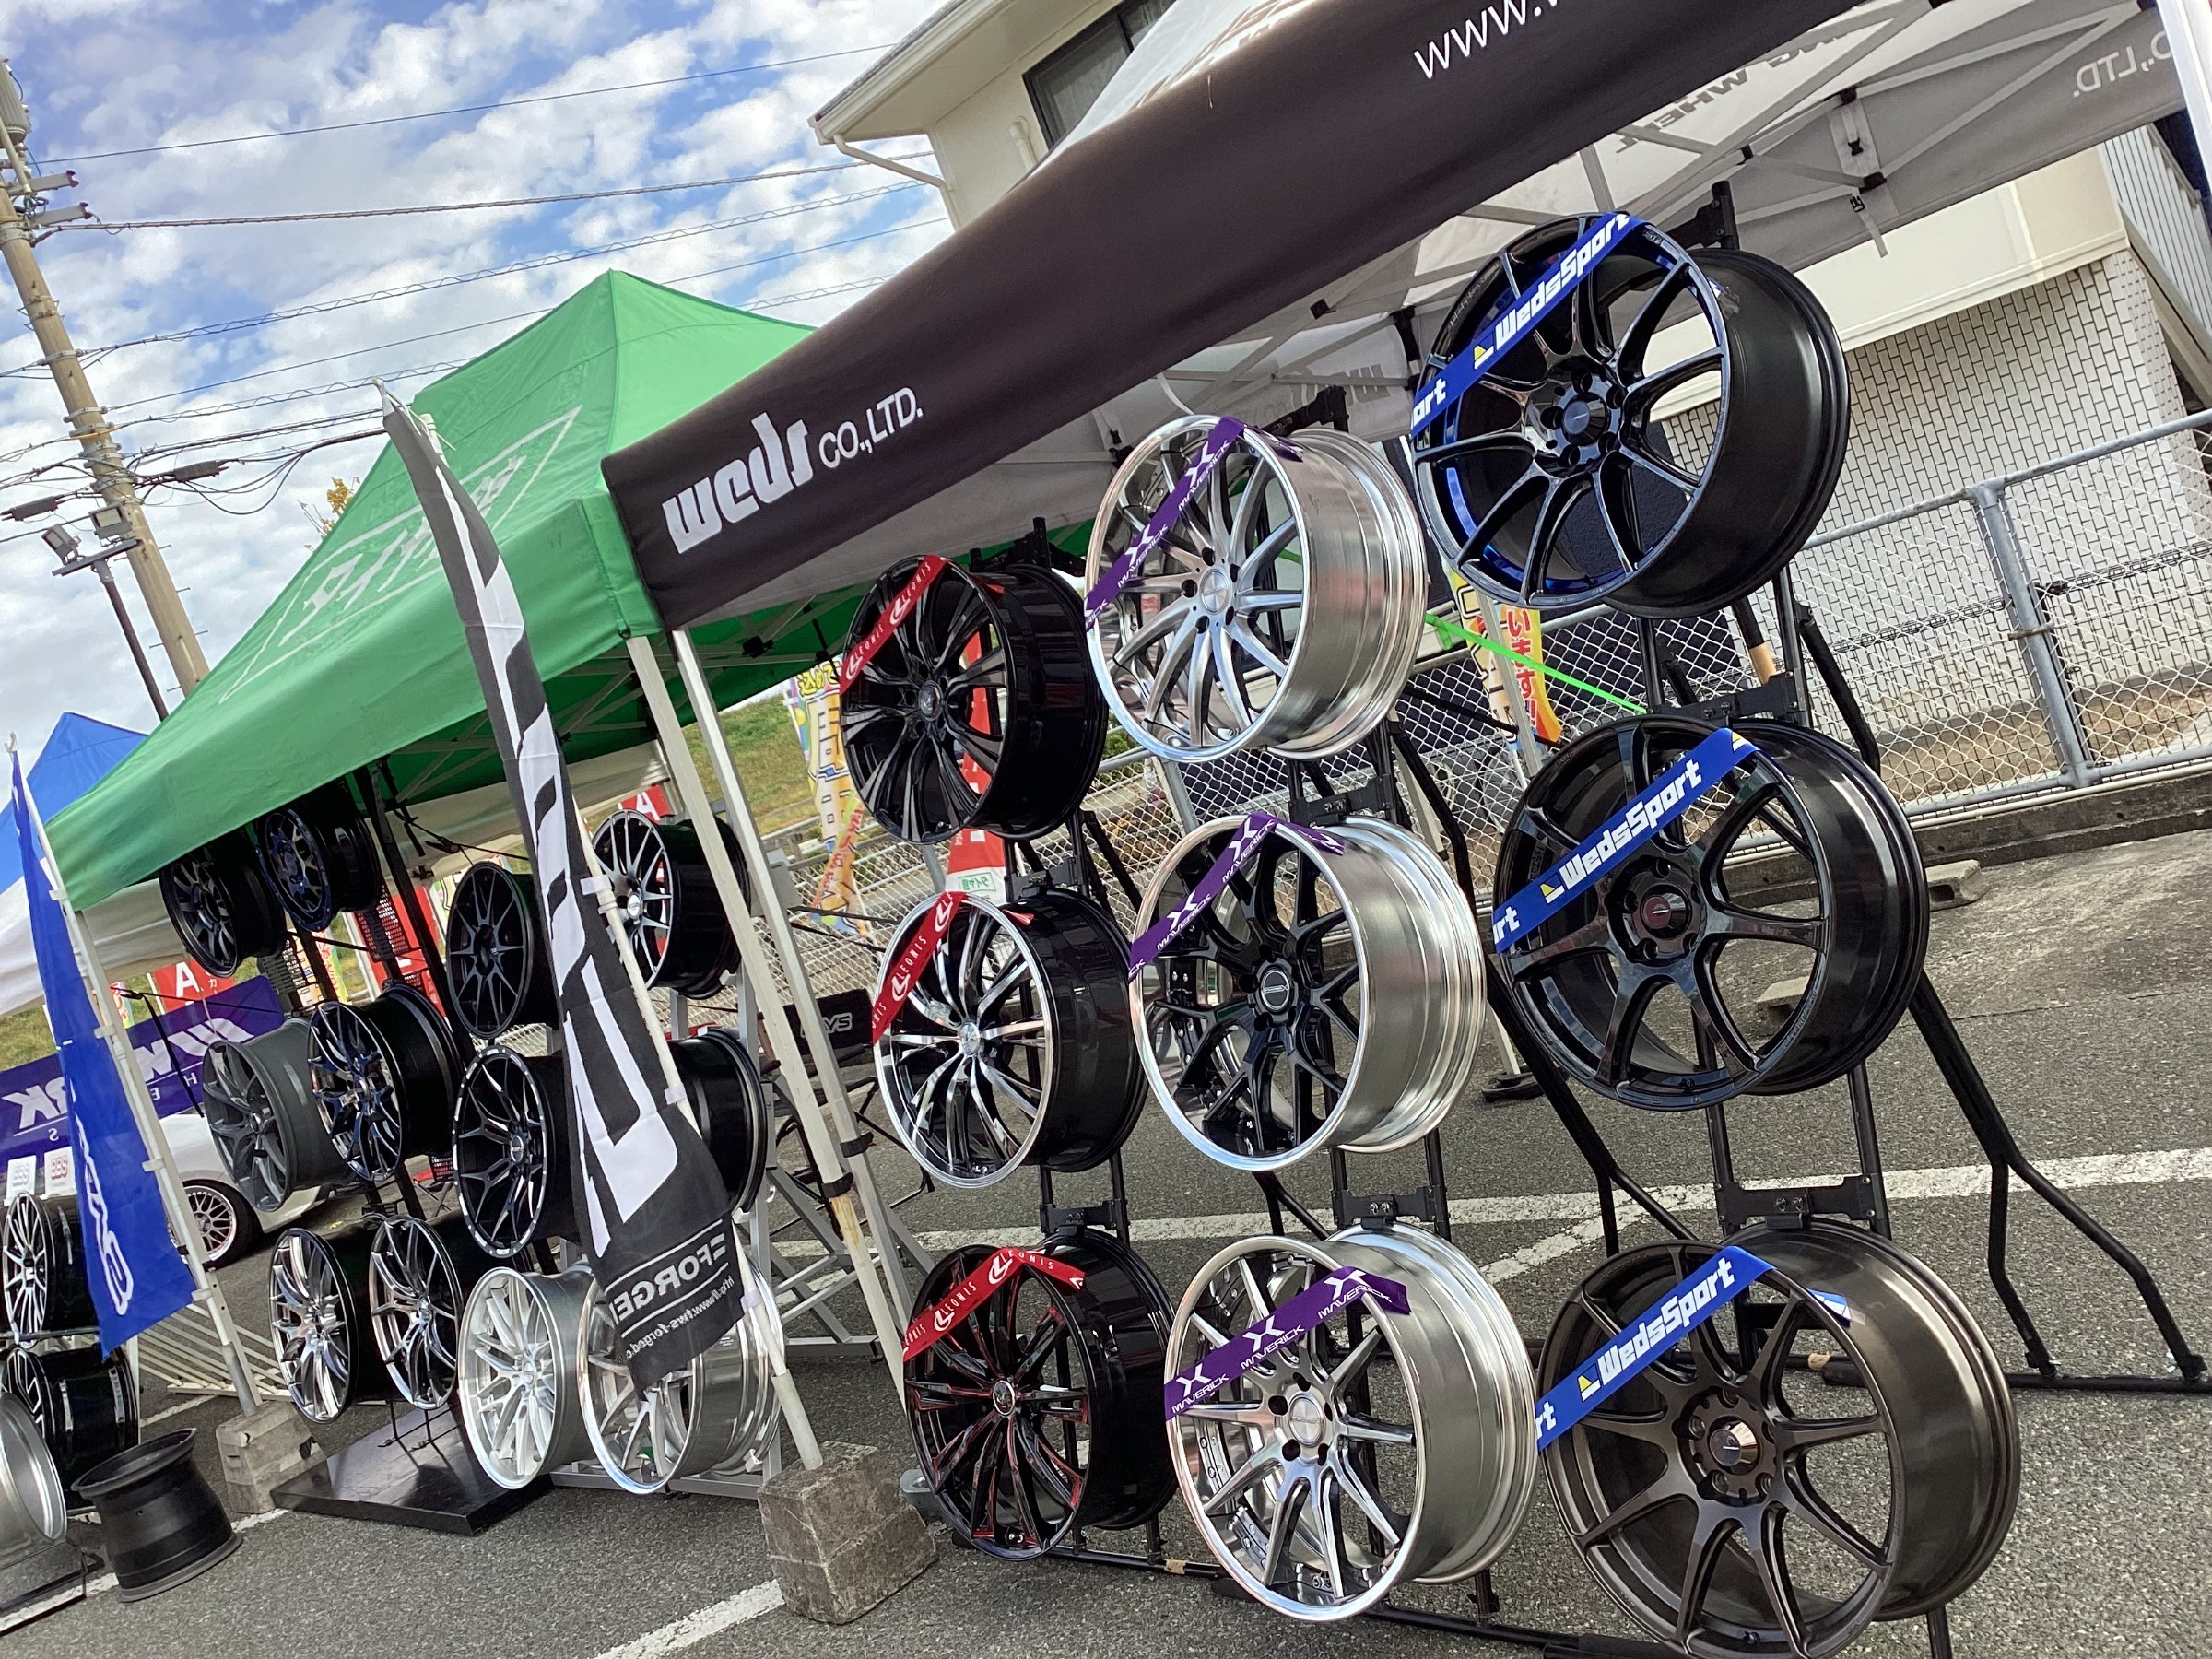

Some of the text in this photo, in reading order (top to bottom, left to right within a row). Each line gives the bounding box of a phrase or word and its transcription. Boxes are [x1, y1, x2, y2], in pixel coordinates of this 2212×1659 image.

[1413, 0, 1559, 79] www.
[1494, 213, 1630, 349] WedsSport
[818, 386, 923, 469] CO.,LTD.
[1178, 439, 1230, 511] MAVERICK
[900, 561, 931, 604] LEONIS
[1117, 522, 1169, 588] MAVERICK
[853, 625, 884, 664] LEONIS
[1222, 818, 1277, 884] MAVERICK
[1559, 758, 1704, 890] WedsSport
[1157, 893, 1212, 951] MAVERICK
[896, 935, 926, 981] LEONIS
[939, 1281, 977, 1316] LEONIS
[1317, 1284, 1393, 1320] MAVERICK
[1597, 1256, 1736, 1385] WedsSport
[1240, 1324, 1305, 1370] MAVERICK
[1171, 1372, 1230, 1415] MAVERICK
